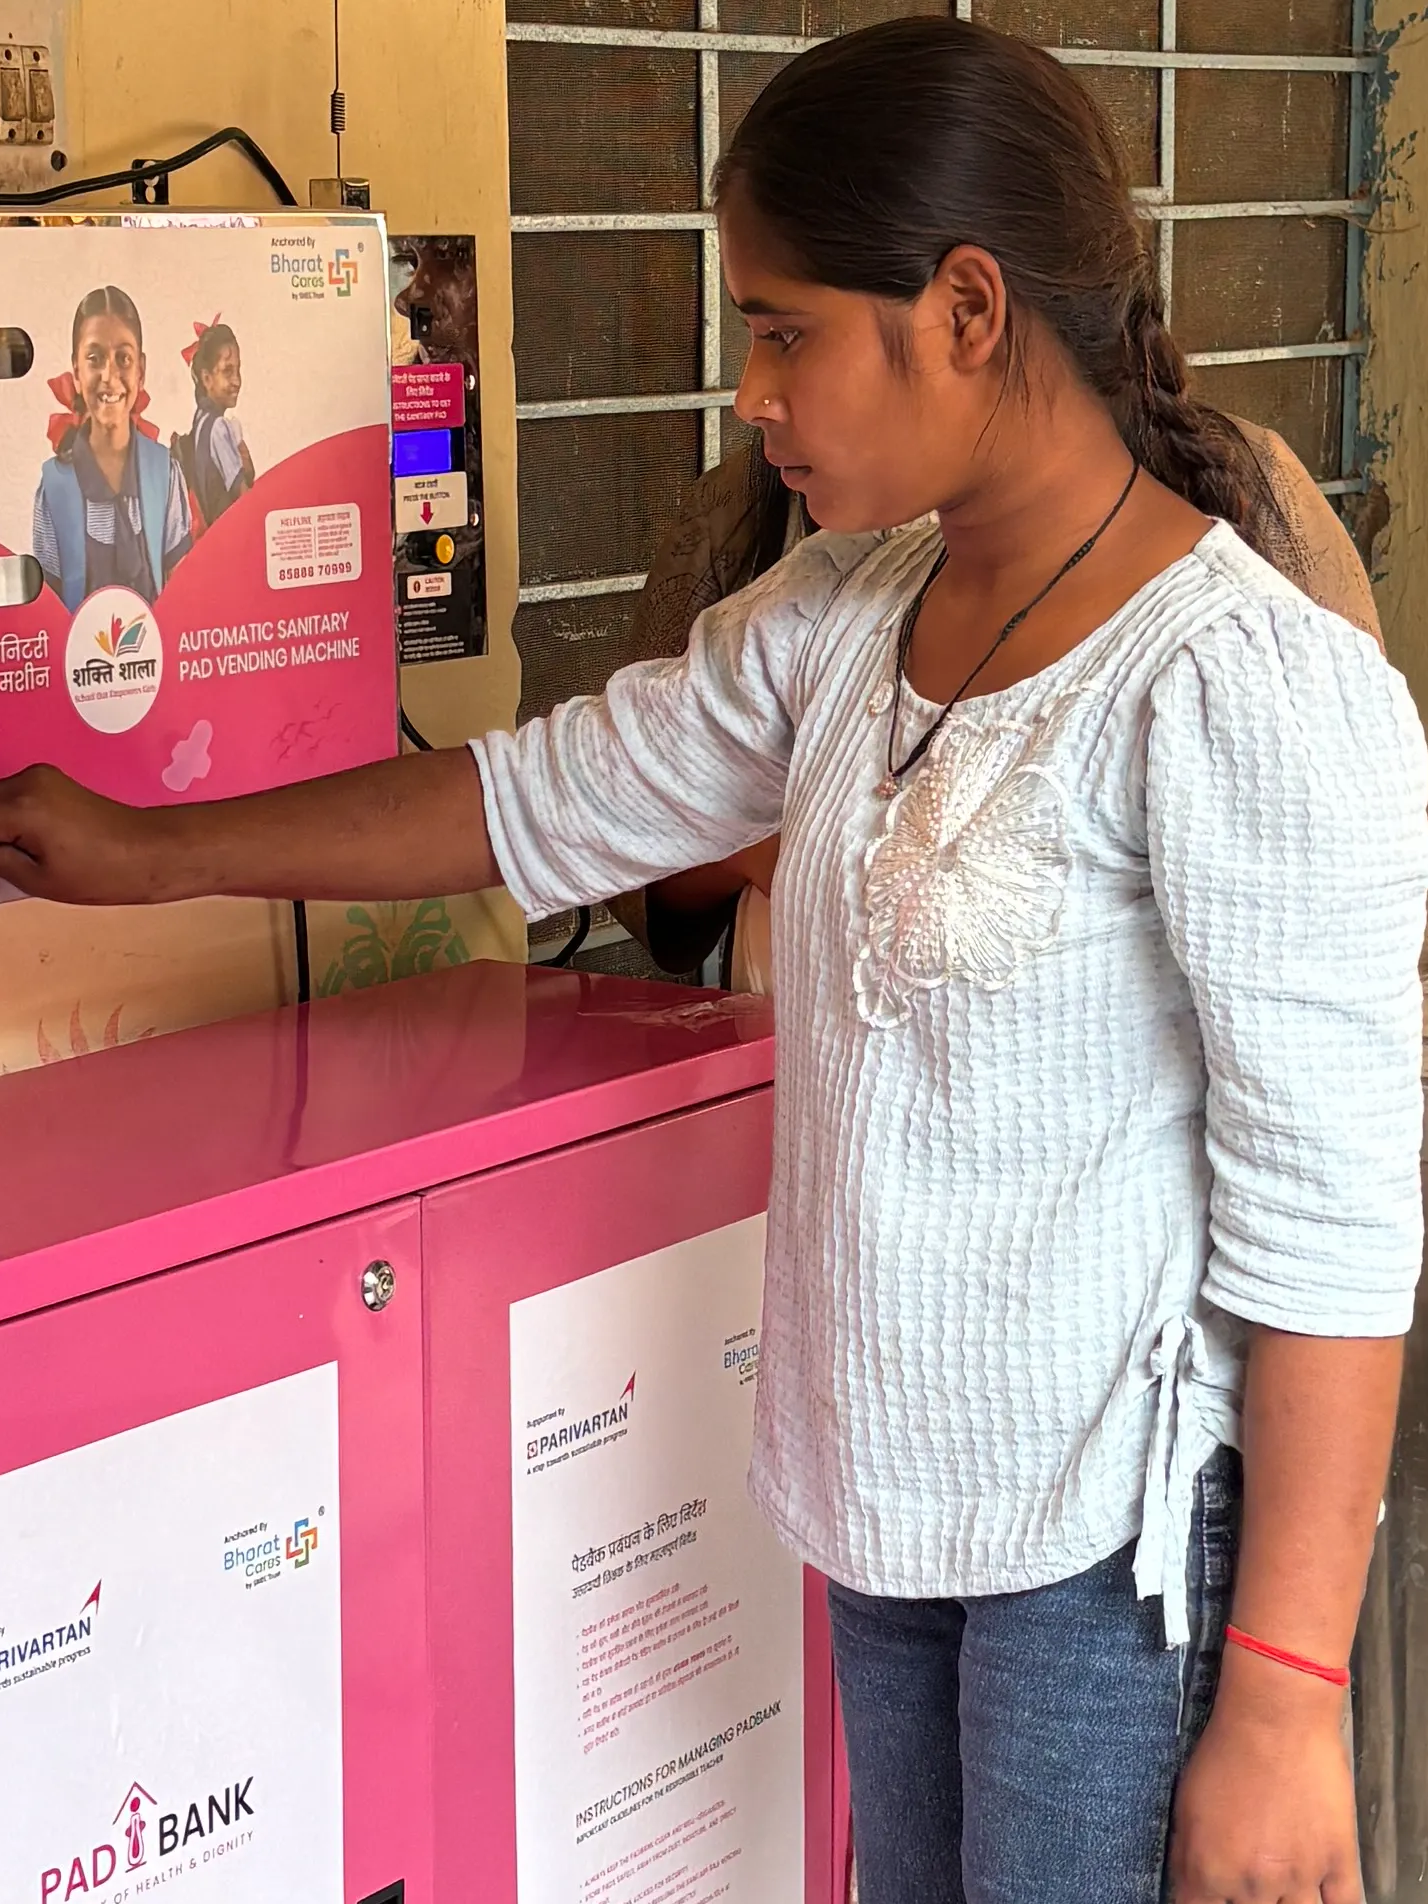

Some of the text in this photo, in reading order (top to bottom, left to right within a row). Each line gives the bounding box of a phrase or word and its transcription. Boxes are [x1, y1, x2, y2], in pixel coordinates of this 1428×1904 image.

[271, 251, 323, 274] Bharat
[291, 273, 324, 288] Cares
[279, 561, 351, 581] 85888 70999
[178, 610, 350, 654] AUTOMATIC SANITARY
[72, 656, 156, 688] शक्ति शाला
[179, 636, 359, 682] PAD VENDING MACHINE
[724, 1339, 757, 1368] Bhara
[540, 1402, 627, 1454] PARIVARTAN
[224, 1532, 279, 1571] Bharat
[245, 1553, 280, 1578] Cares
[576, 1698, 781, 1829] INSTRUCTIONS FOR MANAGING PADBANK
[158, 1775, 254, 1857] BANK
[136, 1862, 183, 1895] HEALTH
[190, 1856, 196, 1870] &
[203, 1828, 253, 1863] DIGNITY
